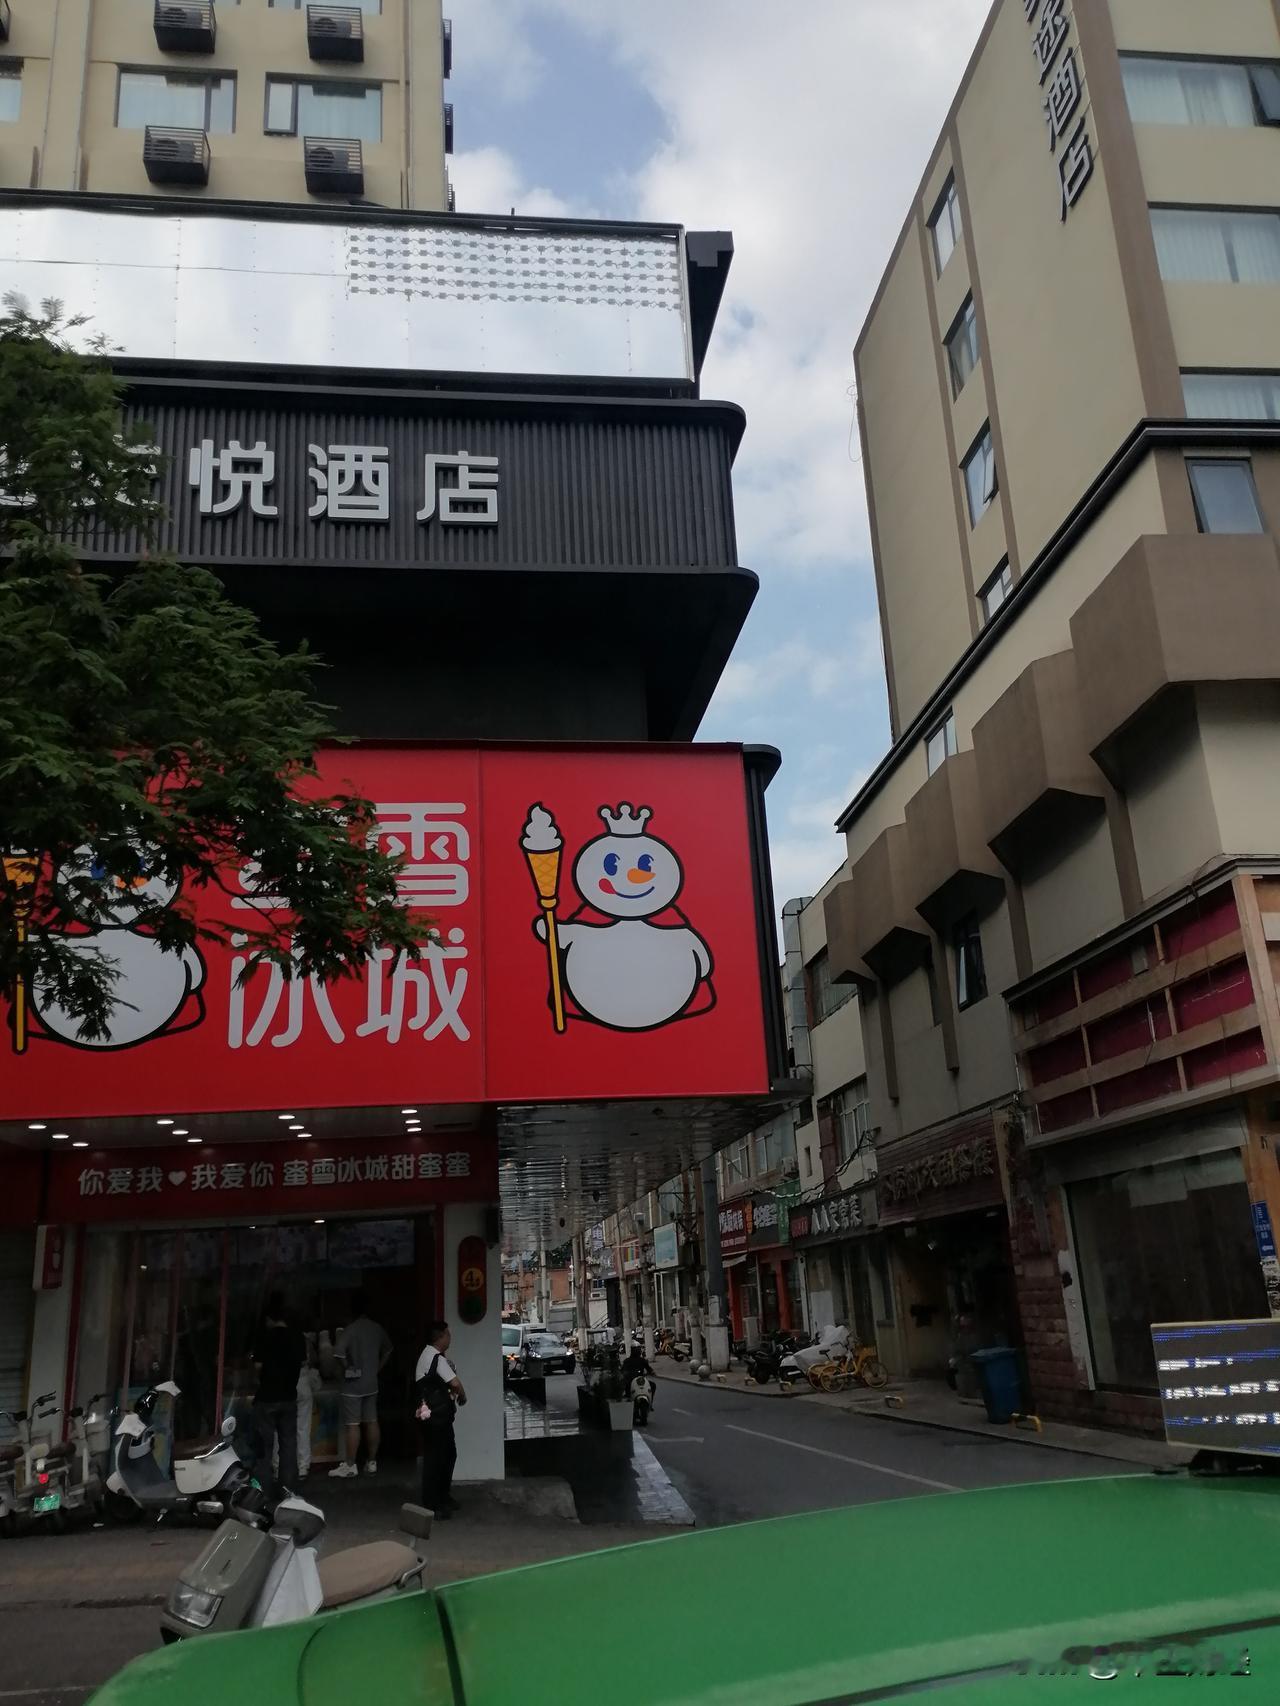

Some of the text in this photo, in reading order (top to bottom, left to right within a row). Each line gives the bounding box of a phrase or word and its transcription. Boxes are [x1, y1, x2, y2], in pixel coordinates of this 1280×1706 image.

[227, 927, 472, 1049] 冰城
[77, 1152, 471, 1196] 你爱我 我爱你 蜜雪冰城甜蜜蜜
